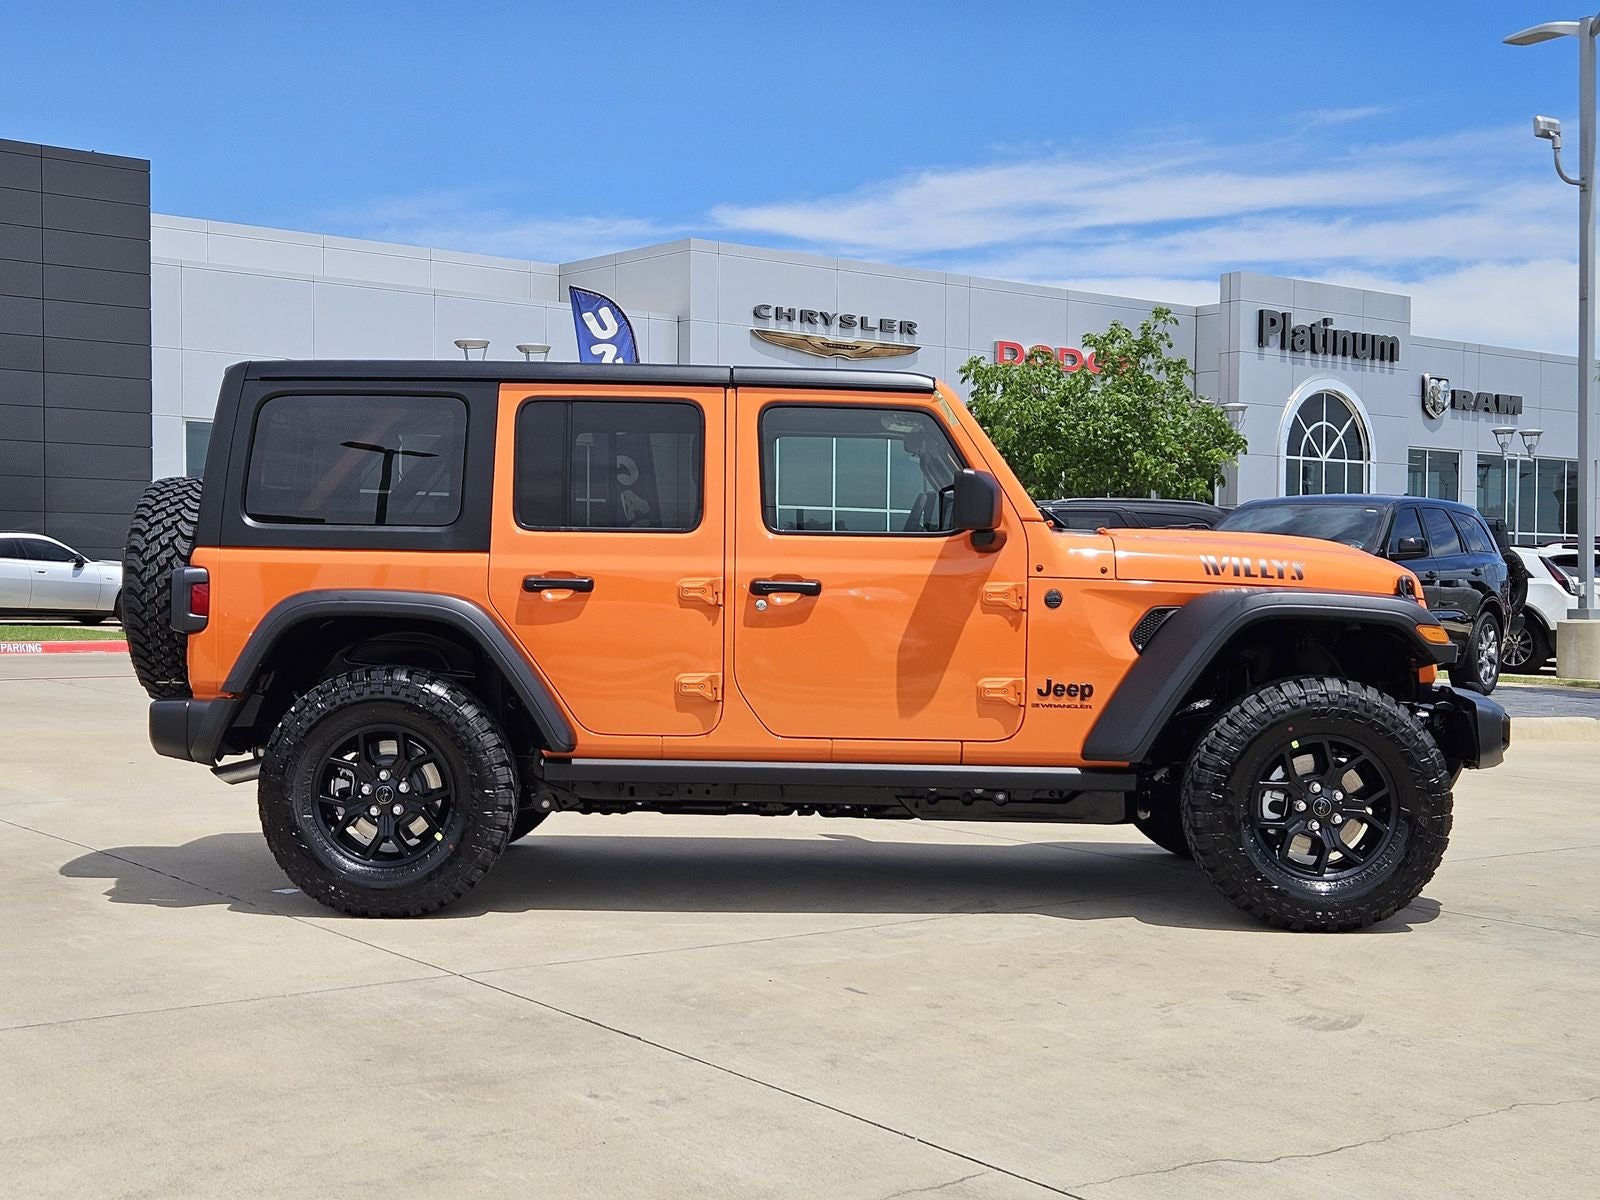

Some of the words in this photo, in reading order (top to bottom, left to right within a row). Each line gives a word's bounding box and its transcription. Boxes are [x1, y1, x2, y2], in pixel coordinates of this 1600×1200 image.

[752, 304, 918, 335] CHRYSLER
[1257, 308, 1400, 363] Platinum
[1450, 389, 1523, 415] RAM
[1199, 554, 1305, 581] WILLYS
[0, 643, 43, 653] PARKING
[1036, 677, 1094, 702] Jeep
